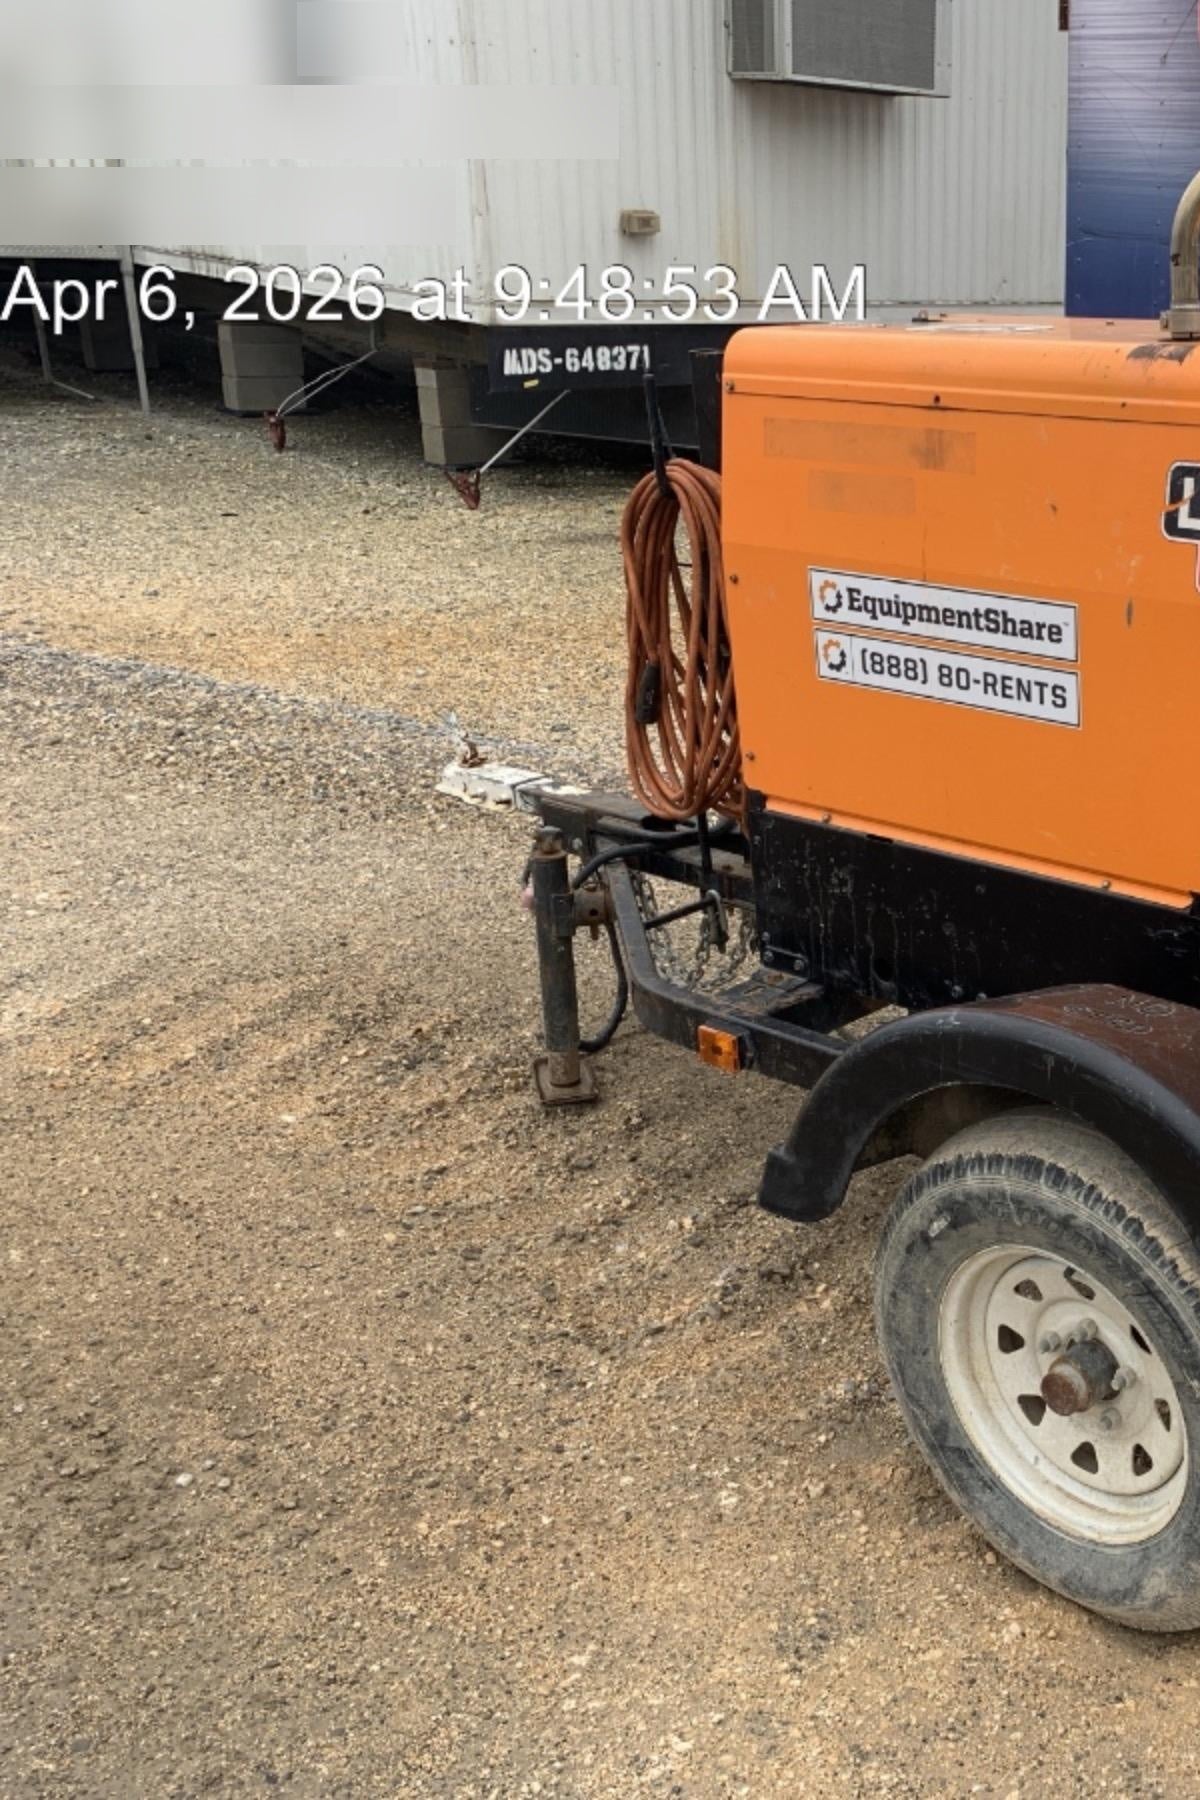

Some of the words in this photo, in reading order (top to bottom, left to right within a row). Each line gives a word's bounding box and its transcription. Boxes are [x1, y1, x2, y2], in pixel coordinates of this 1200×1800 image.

[503, 344, 650, 376] MDS-648371
[846, 586, 1064, 644] EquipmentShare
[860, 647, 929, 685] (888)
[938, 664, 1068, 709] 80-RENTS
